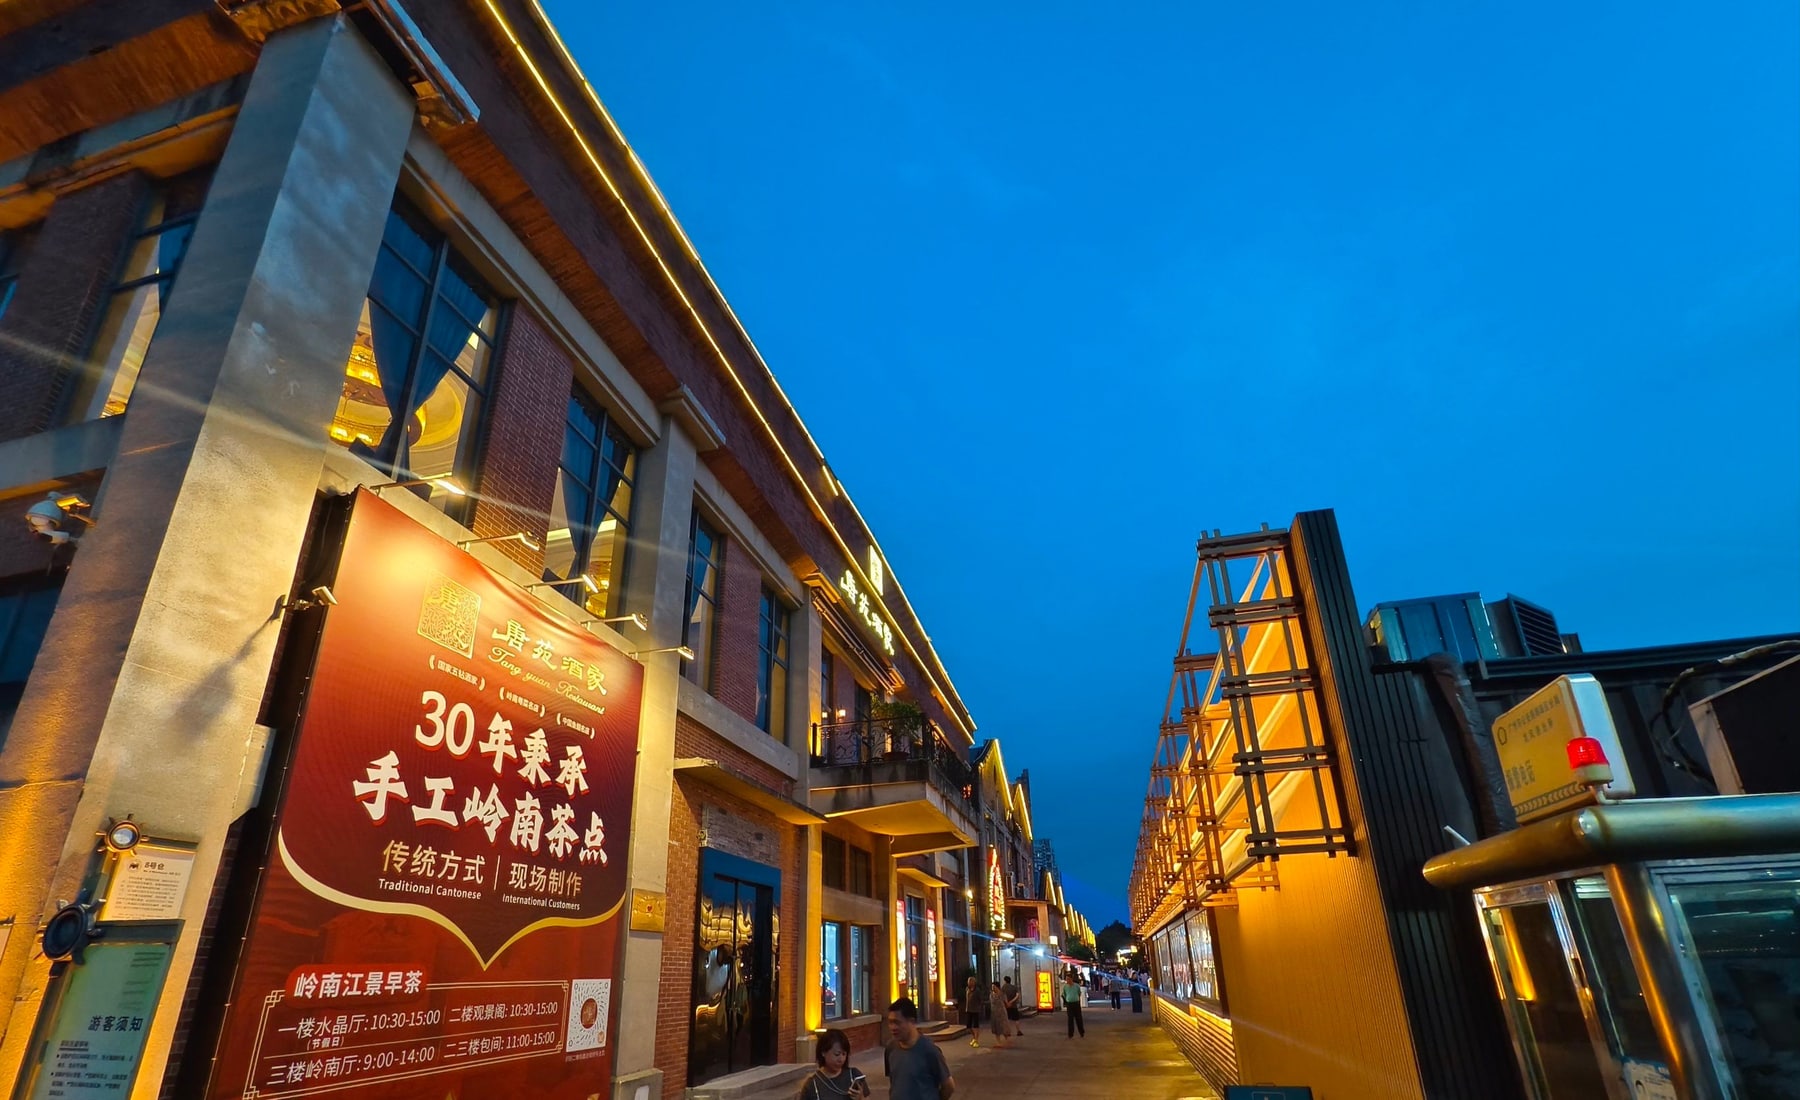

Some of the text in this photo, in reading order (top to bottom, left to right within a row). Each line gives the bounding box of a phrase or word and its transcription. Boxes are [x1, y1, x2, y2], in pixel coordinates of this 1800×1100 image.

[491, 618, 607, 696] 唐苑酒家
[488, 646, 606, 715] Tang yuan Restaurant
[415, 690, 590, 798] 30年秉承
[352, 750, 608, 865] 手工岭南茶点
[383, 839, 486, 885] 传统方式
[378, 878, 482, 900] Traditional Cantonese
[508, 862, 583, 897] 现场制作
[502, 893, 581, 911] International Customers
[293, 970, 423, 999] 岭南江景早茶
[370, 1009, 441, 1031] 10:30-15:00
[510, 1001, 558, 1017] 10:30-15:00
[88, 1015, 144, 1032] 游客须知
[506, 1031, 555, 1049] 11:00-15:00
[362, 1046, 436, 1071] 9:00-14:00
